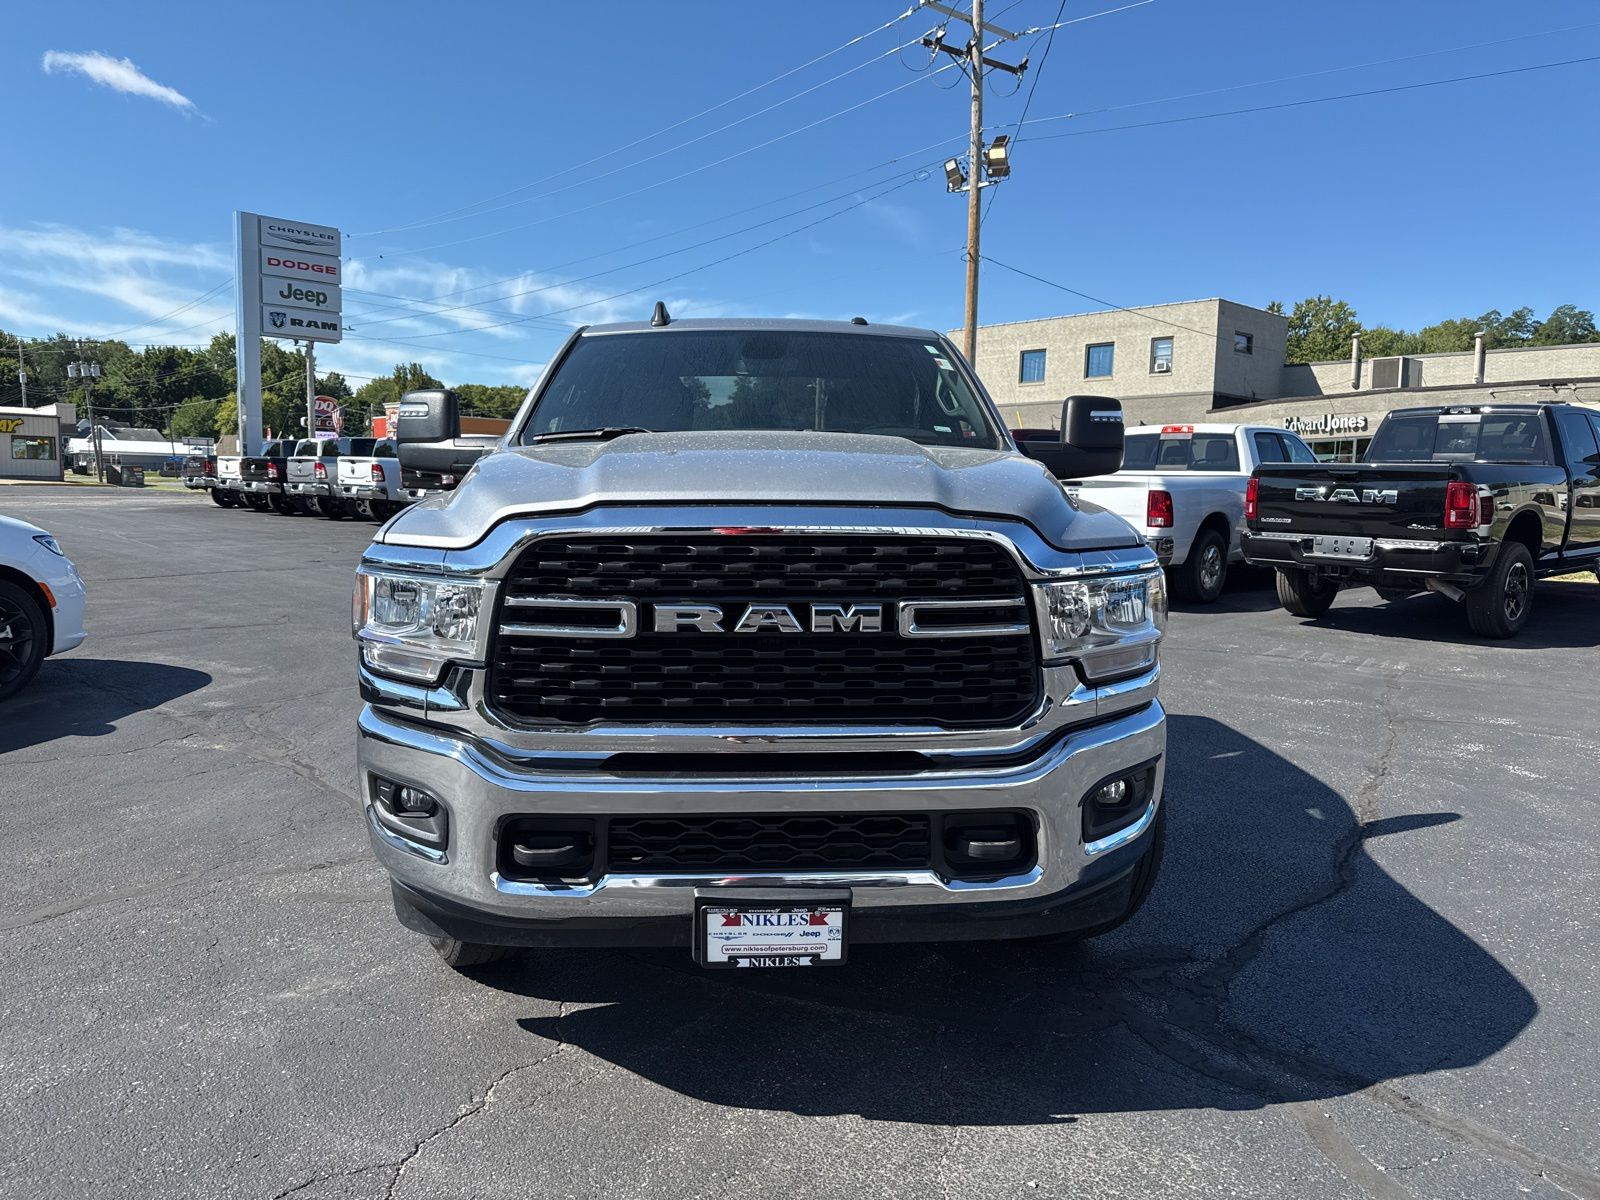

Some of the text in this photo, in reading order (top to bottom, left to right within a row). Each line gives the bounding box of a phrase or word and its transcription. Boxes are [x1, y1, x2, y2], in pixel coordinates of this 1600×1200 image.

[268, 225, 335, 240] CHRYSLER
[267, 257, 337, 275] DODGE
[279, 283, 328, 306] Jeep
[290, 318, 338, 331] RAM
[315, 401, 334, 412] DQ
[1283, 414, 1366, 431] Edward Jones
[1295, 488, 1398, 504] RAM
[653, 603, 882, 632] RAM
[742, 914, 809, 927] NIKLES
[799, 930, 821, 938] Jeep
[724, 945, 826, 954] www.niklesofpetersburg.com
[750, 957, 801, 968] NIKLES
